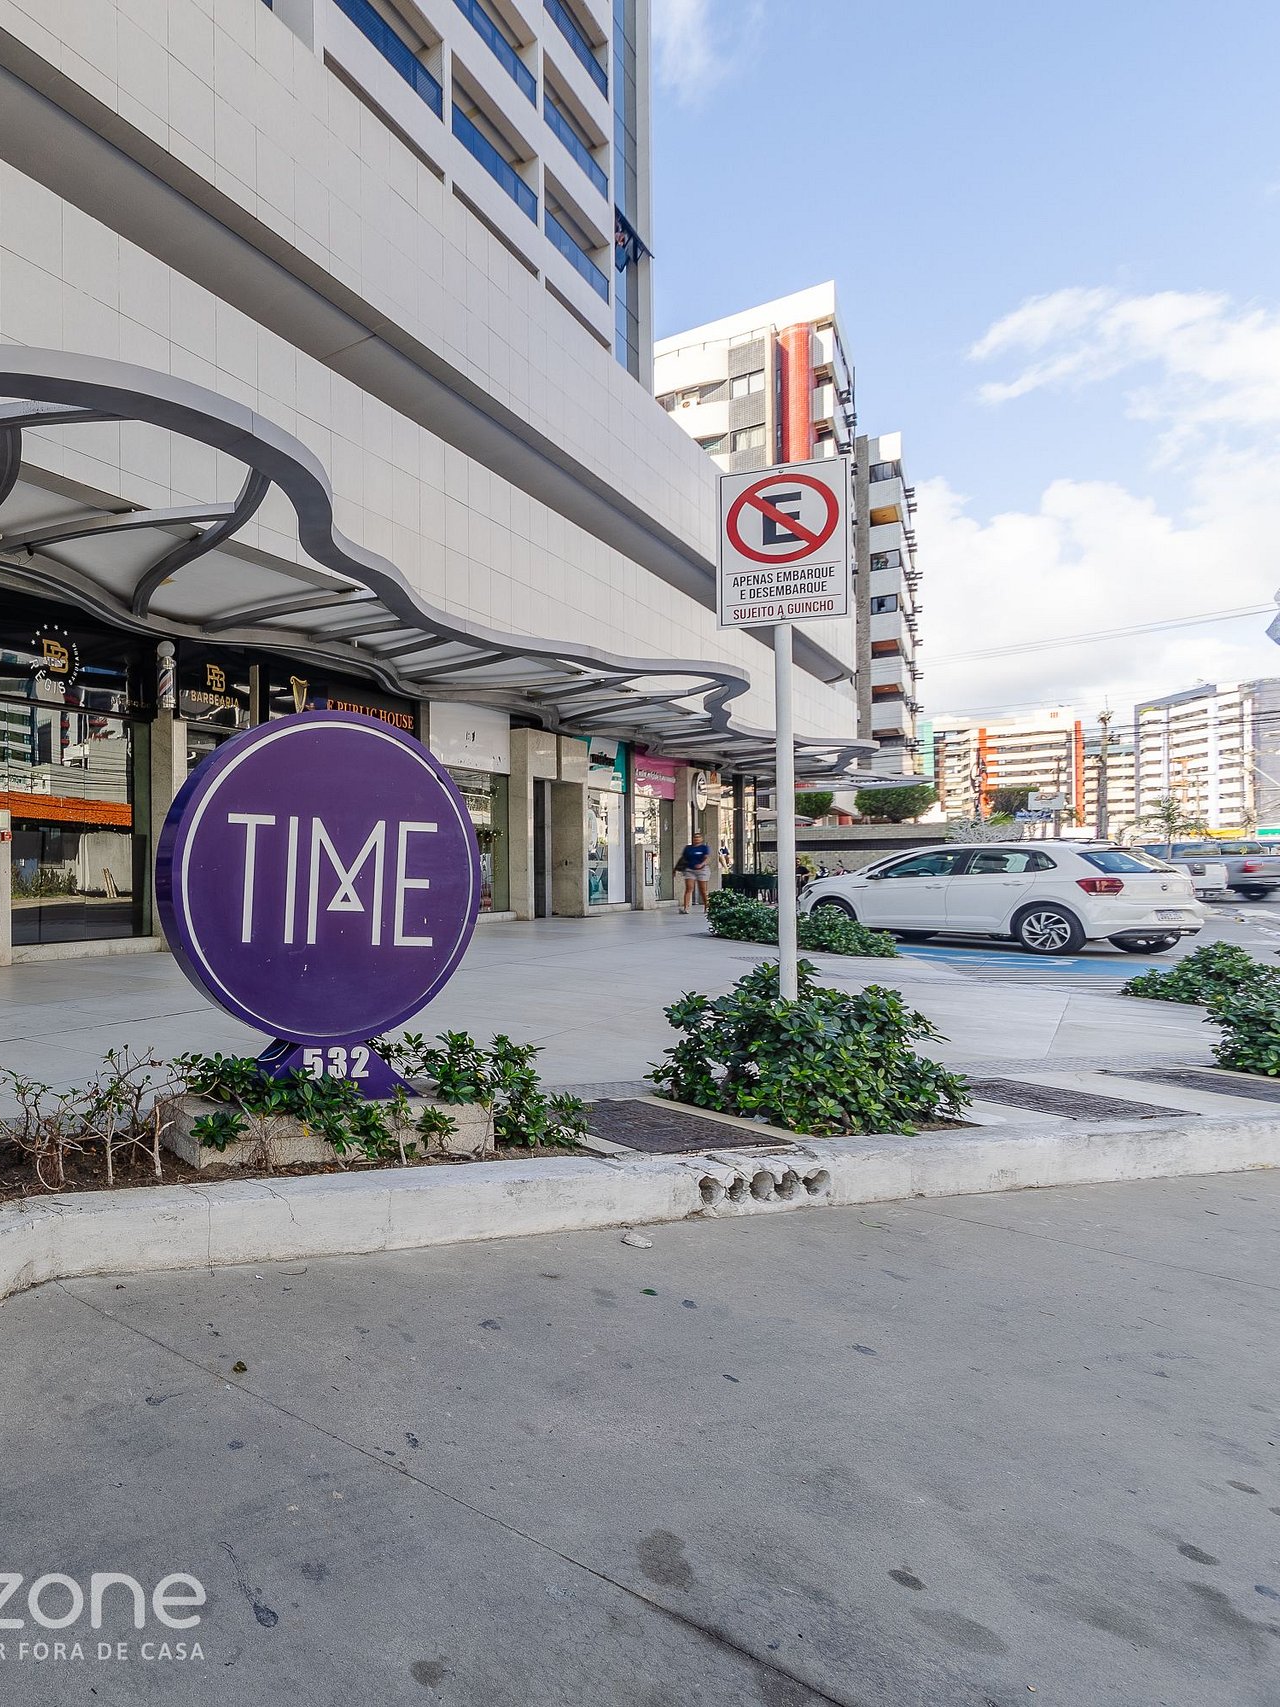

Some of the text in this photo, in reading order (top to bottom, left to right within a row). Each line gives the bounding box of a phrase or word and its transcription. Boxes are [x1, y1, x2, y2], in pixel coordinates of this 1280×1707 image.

[732, 566, 835, 588] APENAS EMBARQUE
[740, 581, 828, 600] E DESEMBARQUE
[733, 599, 834, 620] SUJEITO A GUINCHO
[190, 689, 239, 709] BARBEARIA
[379, 709, 414, 730] HOUSE
[227, 813, 438, 947] TIME
[303, 1046, 370, 1080] 532
